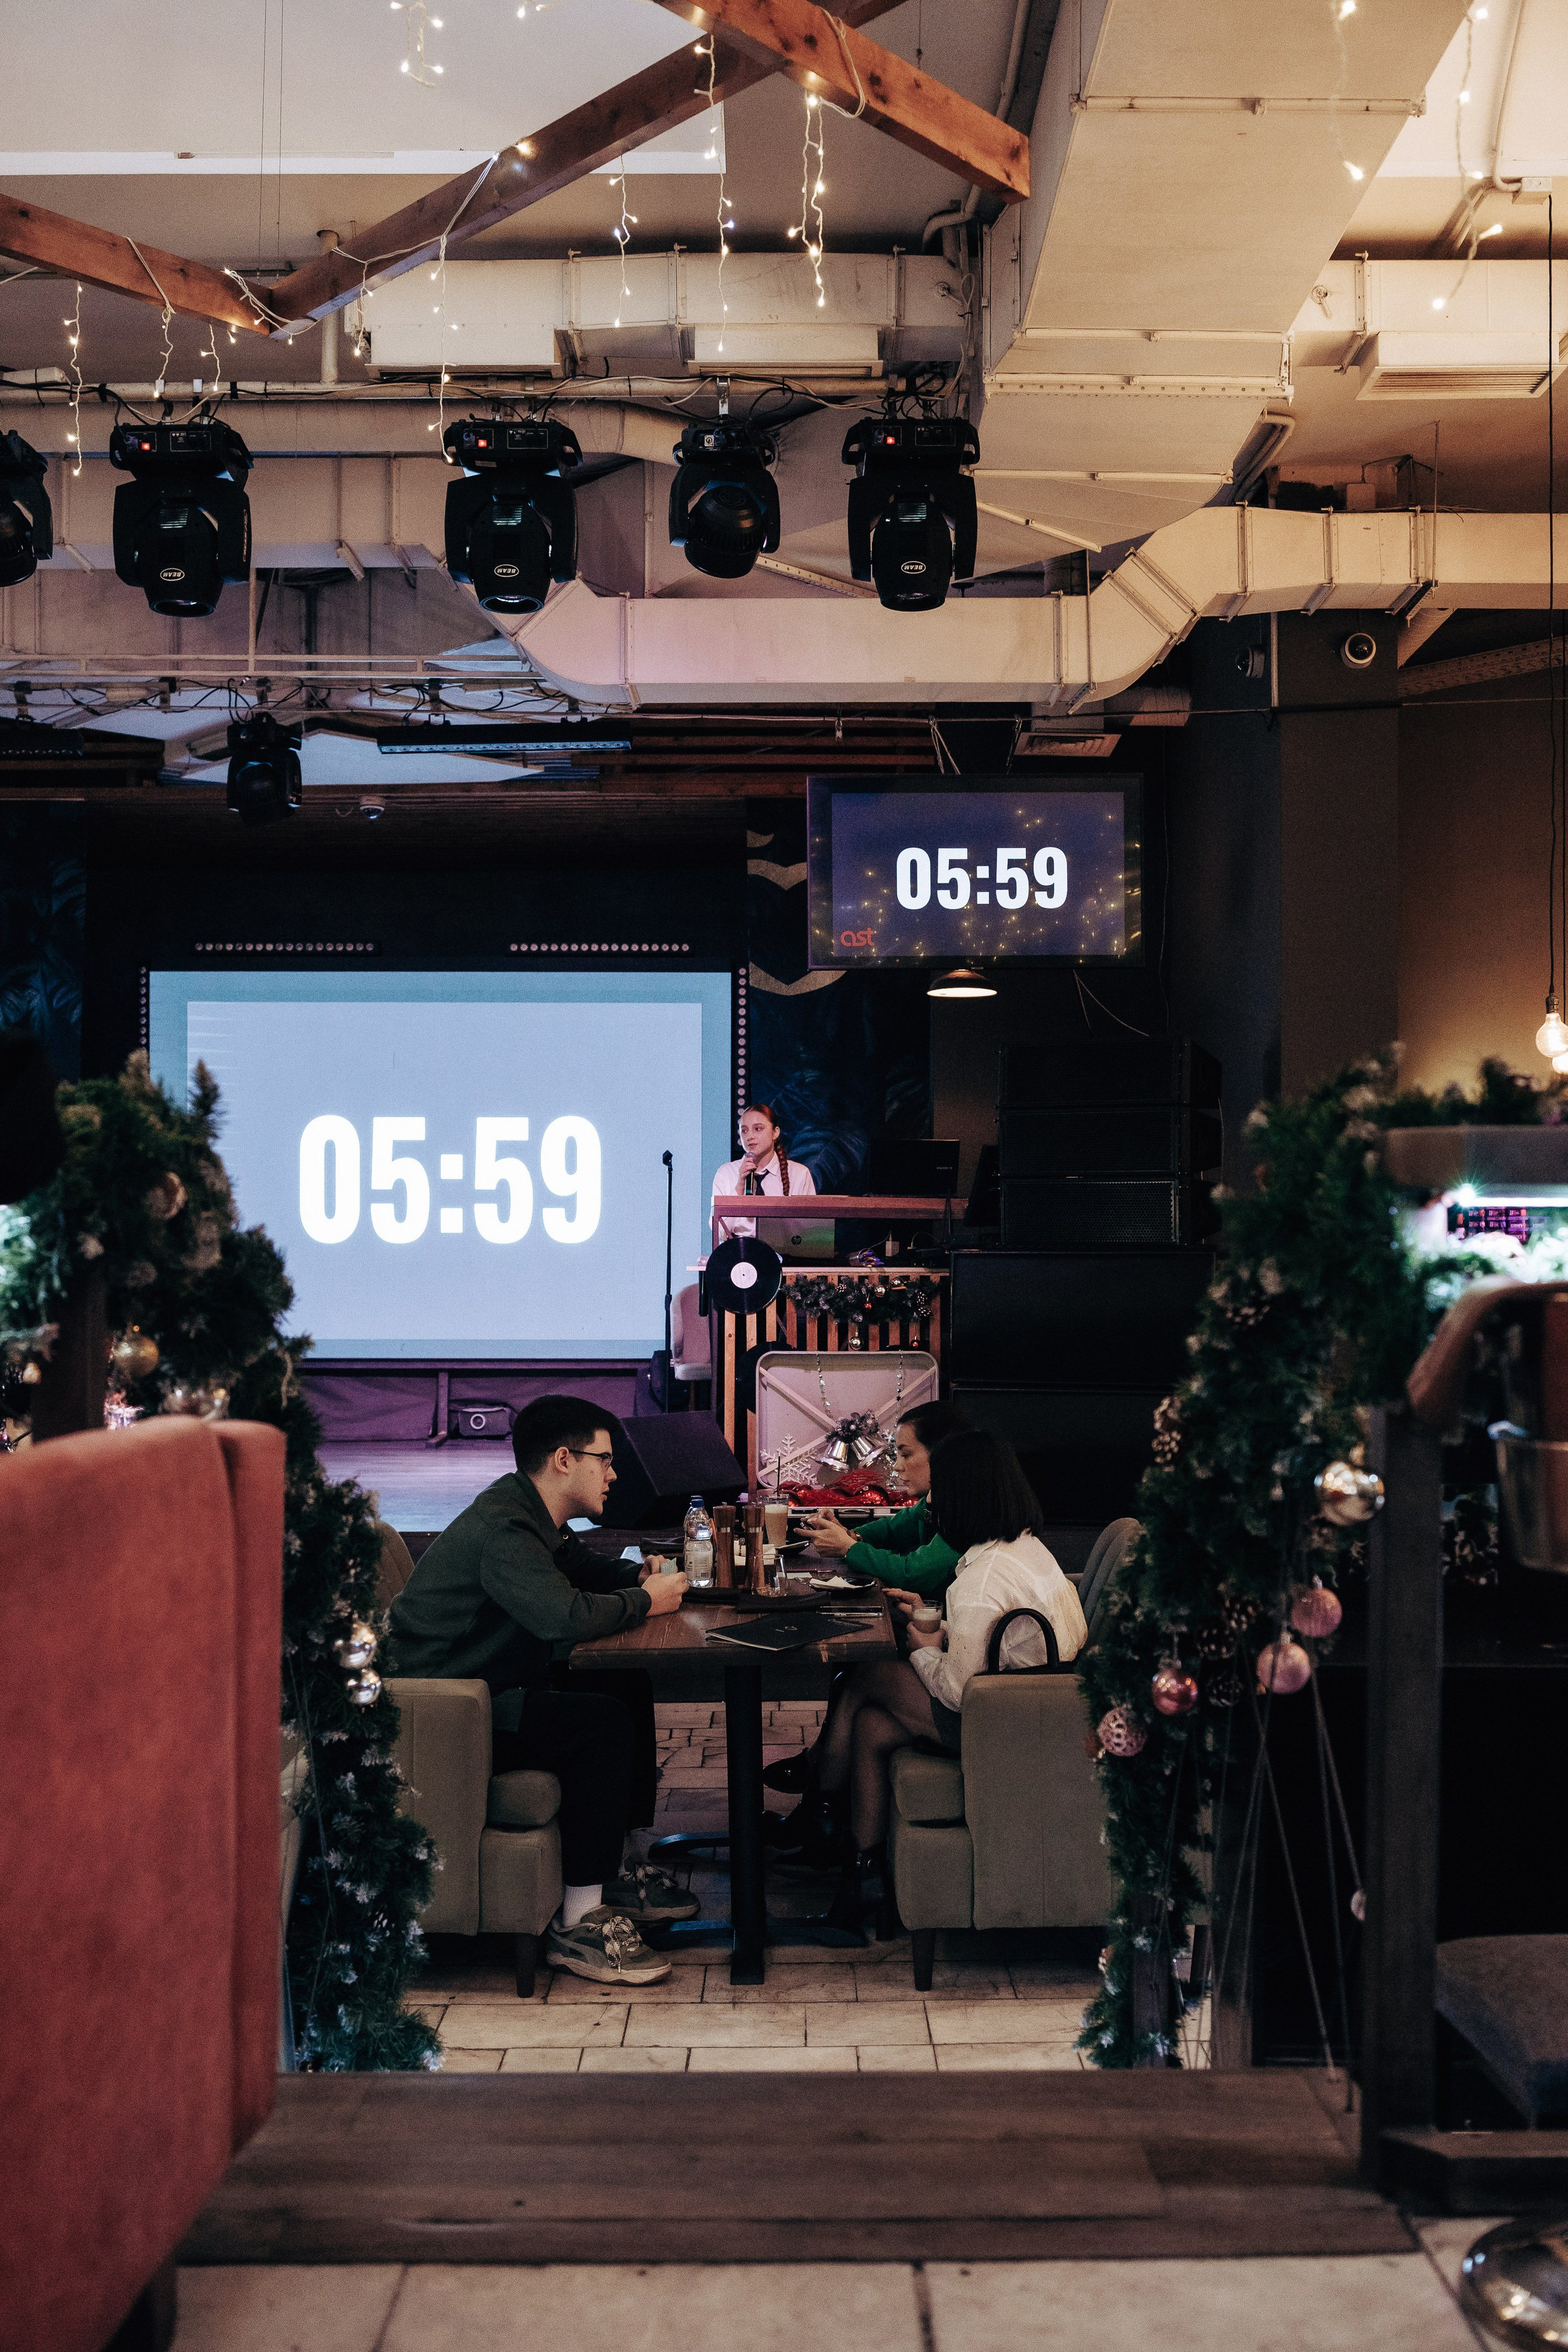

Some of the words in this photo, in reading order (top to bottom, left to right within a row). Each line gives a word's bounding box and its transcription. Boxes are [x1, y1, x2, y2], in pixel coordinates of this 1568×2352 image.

[896, 846, 1068, 910] 05:59
[840, 927, 875, 947] ast
[299, 1114, 602, 1244] 05:59
